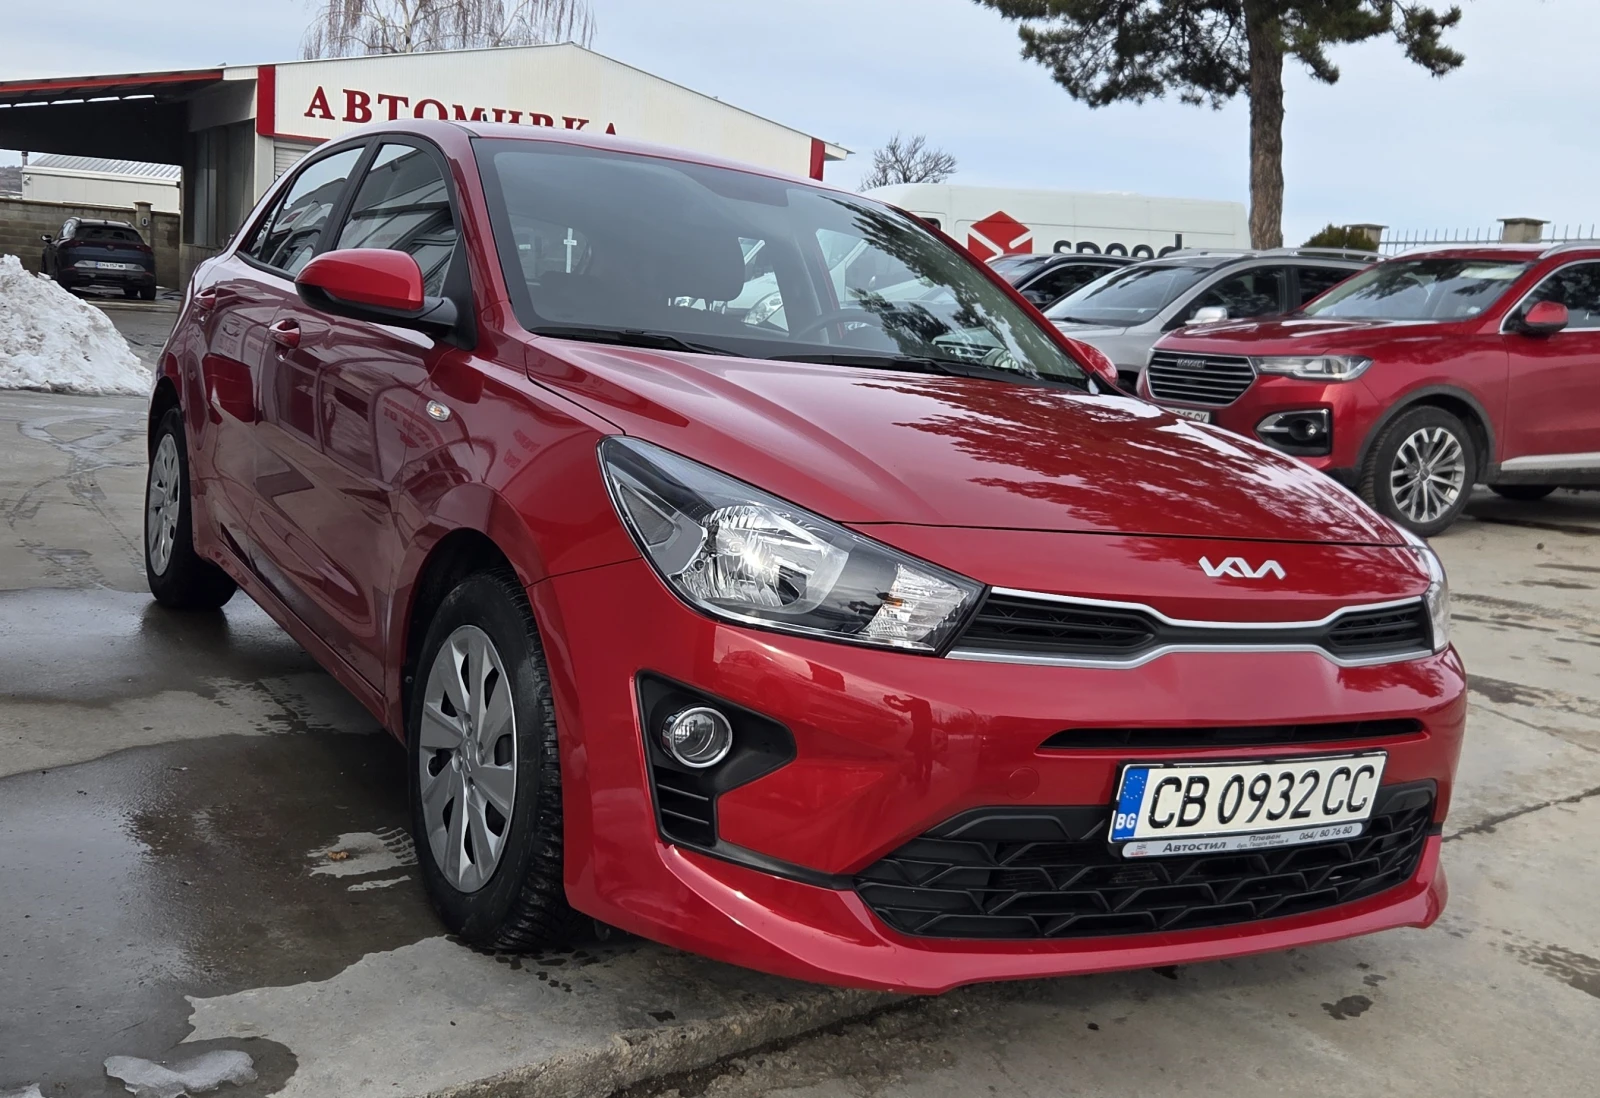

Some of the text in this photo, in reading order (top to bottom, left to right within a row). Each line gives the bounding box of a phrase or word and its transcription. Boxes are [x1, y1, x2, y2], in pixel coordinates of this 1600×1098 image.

[1198, 555, 1287, 580] KIA
[1148, 764, 1375, 829] CB 0932 CC
[1115, 813, 1137, 830] BG
[1162, 841, 1227, 853] Автостил
